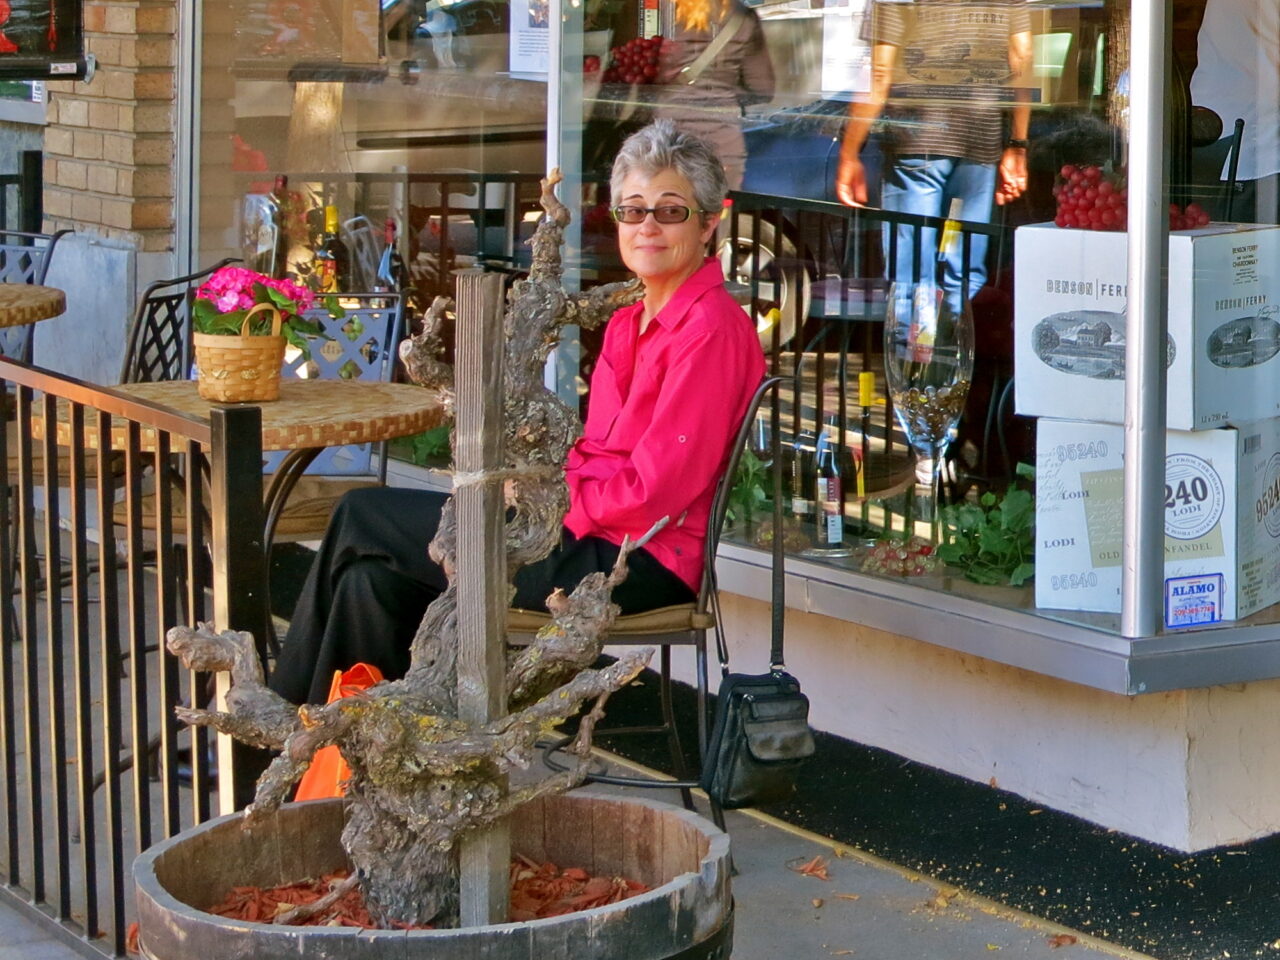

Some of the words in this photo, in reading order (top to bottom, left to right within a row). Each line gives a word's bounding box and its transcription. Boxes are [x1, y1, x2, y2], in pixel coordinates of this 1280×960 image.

[967, 13, 1005, 24] FERRY
[1046, 279, 1093, 296] BENSON
[1245, 295, 1266, 307] FERRY
[1056, 440, 1109, 462] 95240
[1062, 490, 1090, 501] LODI
[1164, 476, 1208, 509] 240
[1172, 504, 1202, 518] LODI
[1044, 537, 1076, 549] LODI
[1164, 542, 1213, 554] NFANDEL
[1099, 551, 1120, 560] OLD
[1050, 571, 1098, 591] 95240
[1172, 583, 1215, 597] ALAMO
